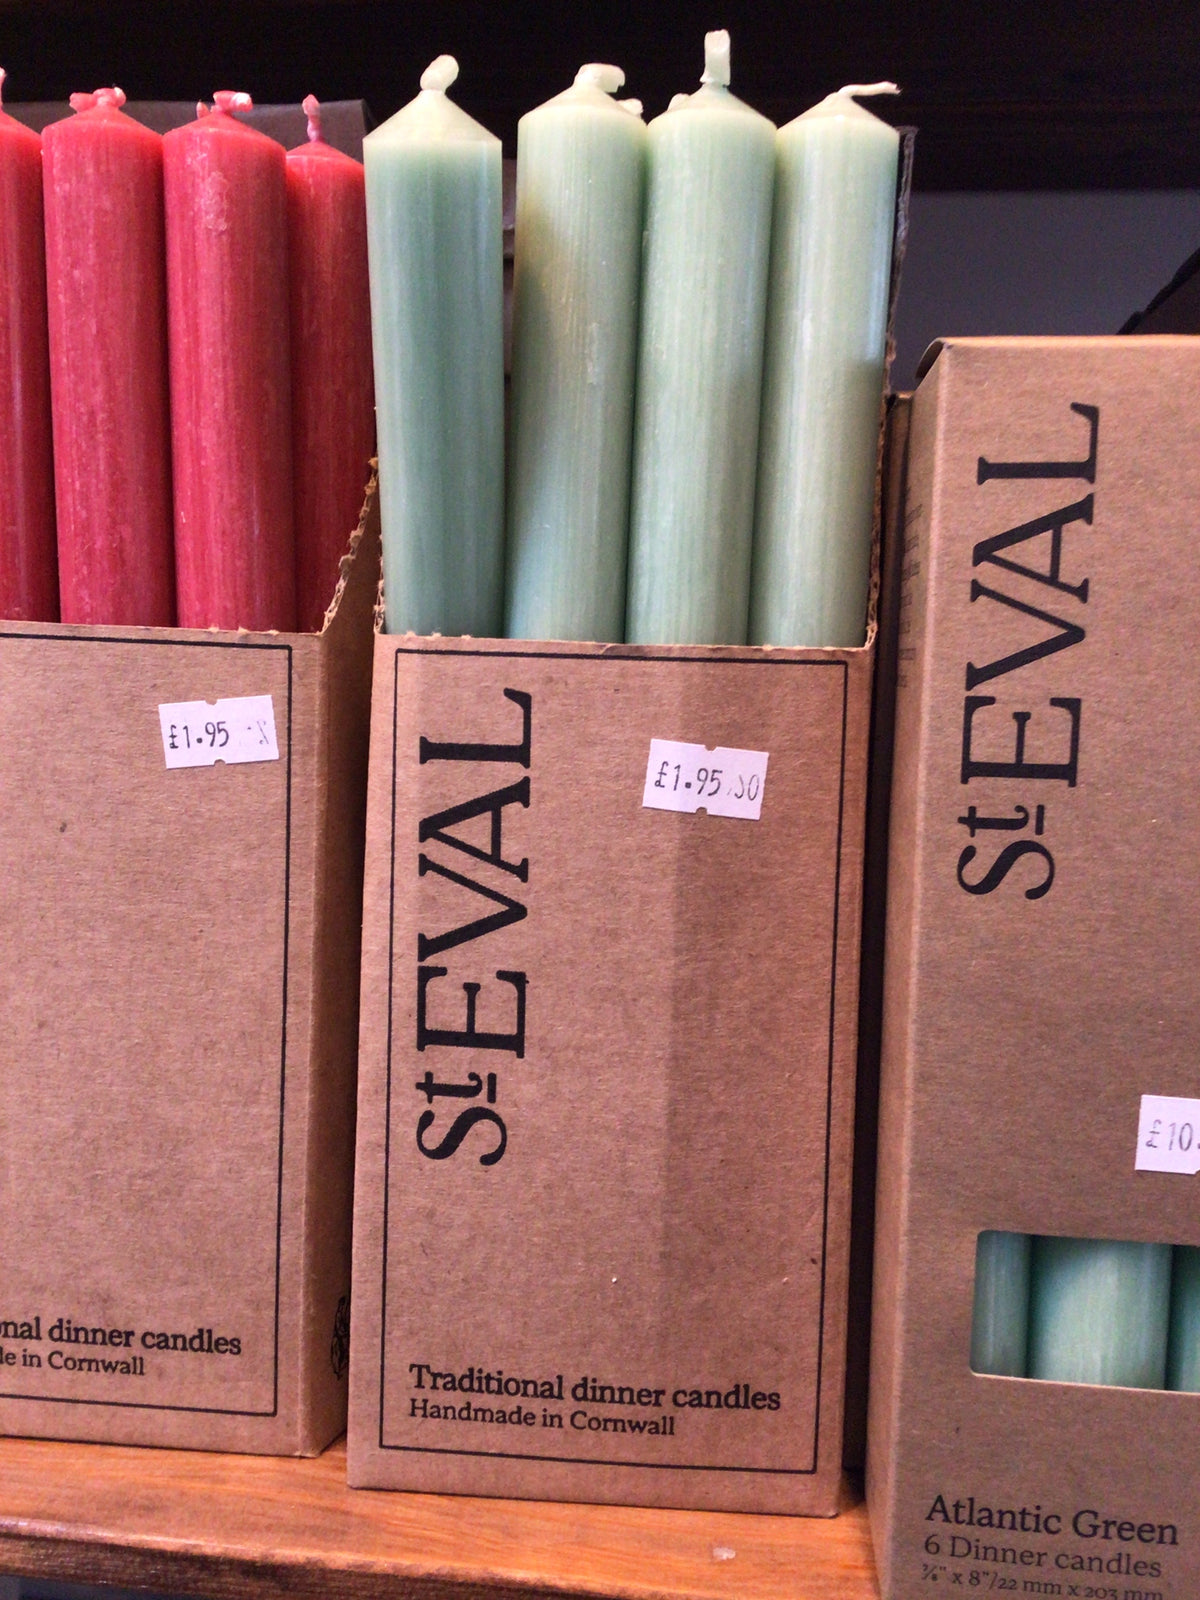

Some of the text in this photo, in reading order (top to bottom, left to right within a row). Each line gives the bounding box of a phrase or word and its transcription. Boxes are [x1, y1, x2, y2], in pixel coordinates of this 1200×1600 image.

[956, 402, 1100, 900] St EVAL
[169, 721, 229, 749] £1.95
[654, 761, 722, 797] £1.95
[416, 687, 532, 1166] St EVAL
[0, 1316, 242, 1355] nal dinner candles
[22, 1349, 42, 1367] in
[48, 1351, 145, 1376] Cornwall
[408, 1363, 781, 1411] Traditional dinner candles
[409, 1398, 675, 1436] Handmade in Cornwall
[925, 1494, 1179, 1546] Atlantic Green
[924, 1534, 1162, 1578] 6 Dinner candles
[952, 1572, 963, 1585] x
[1023, 1580, 1061, 1596] mm
[1068, 1584, 1080, 1597] x
[1085, 1586, 1118, 1600] 203
